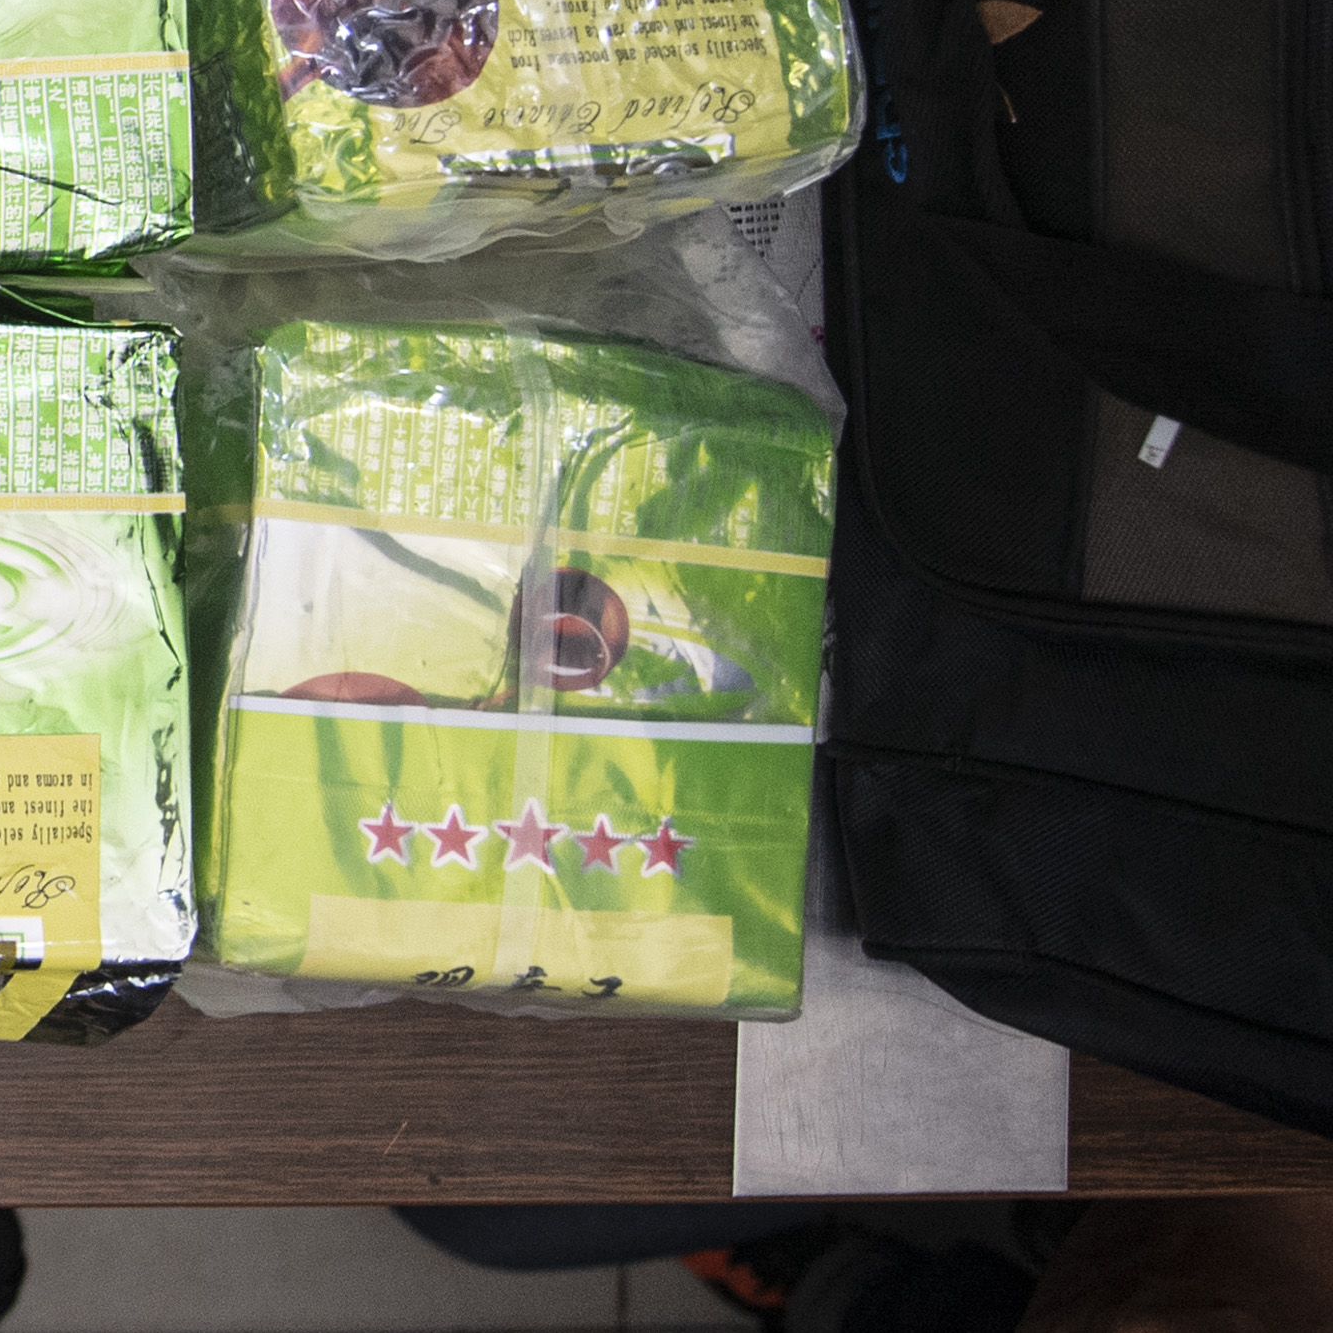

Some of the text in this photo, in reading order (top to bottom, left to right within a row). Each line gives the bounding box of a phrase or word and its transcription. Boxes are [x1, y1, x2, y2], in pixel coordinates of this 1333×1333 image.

[7, 773, 28, 792] and
[35, 773, 72, 787] aroma
[23, 799, 64, 817] finest
[72, 799, 92, 816] the
[31, 821, 92, 845] Specially
